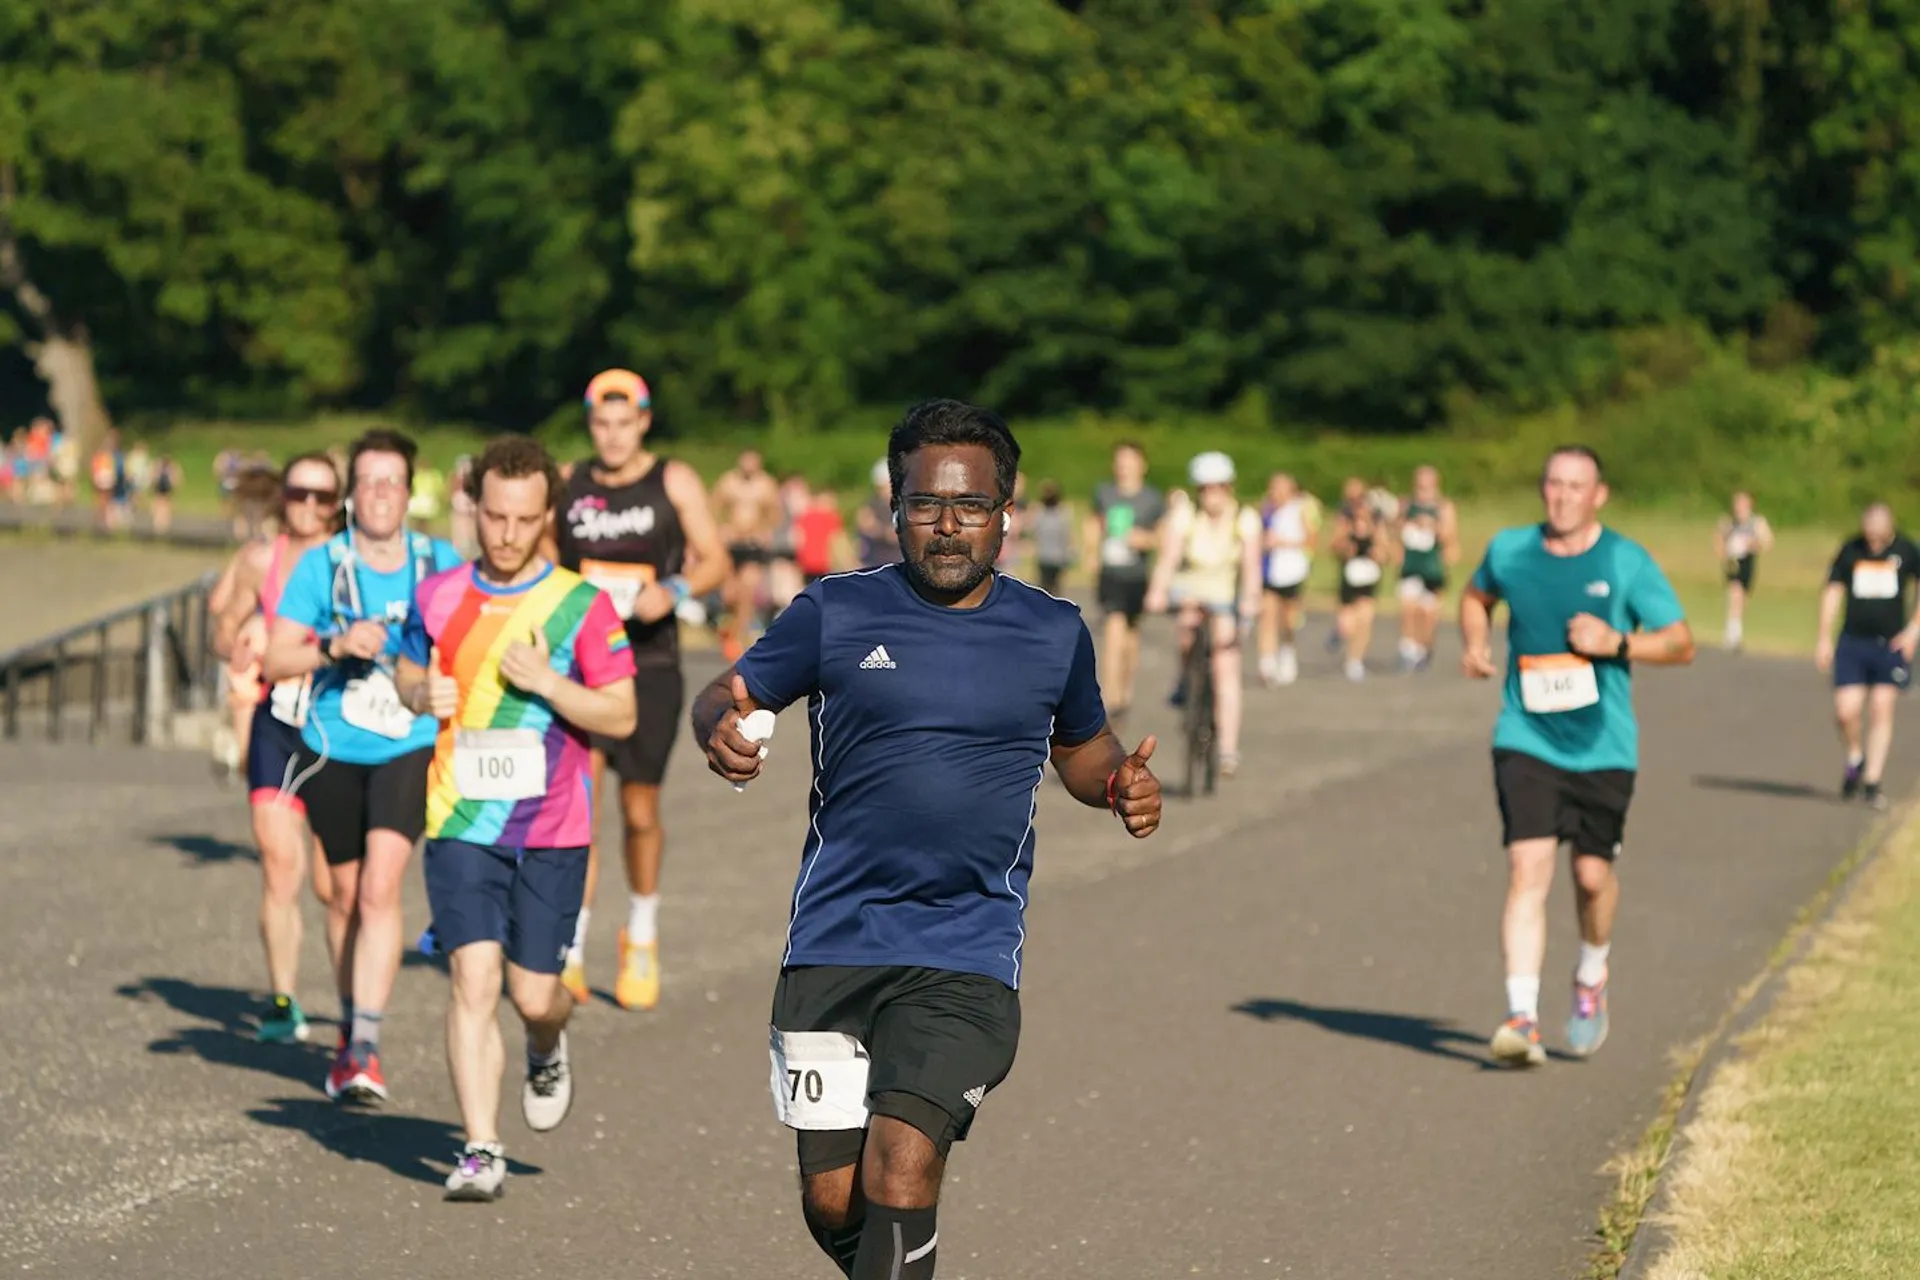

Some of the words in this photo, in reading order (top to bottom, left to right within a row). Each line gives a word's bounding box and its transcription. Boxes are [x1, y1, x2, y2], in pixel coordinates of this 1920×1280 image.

[859, 660, 897, 669] adidas
[478, 756, 515, 779] 100
[787, 1068, 823, 1103] 70
